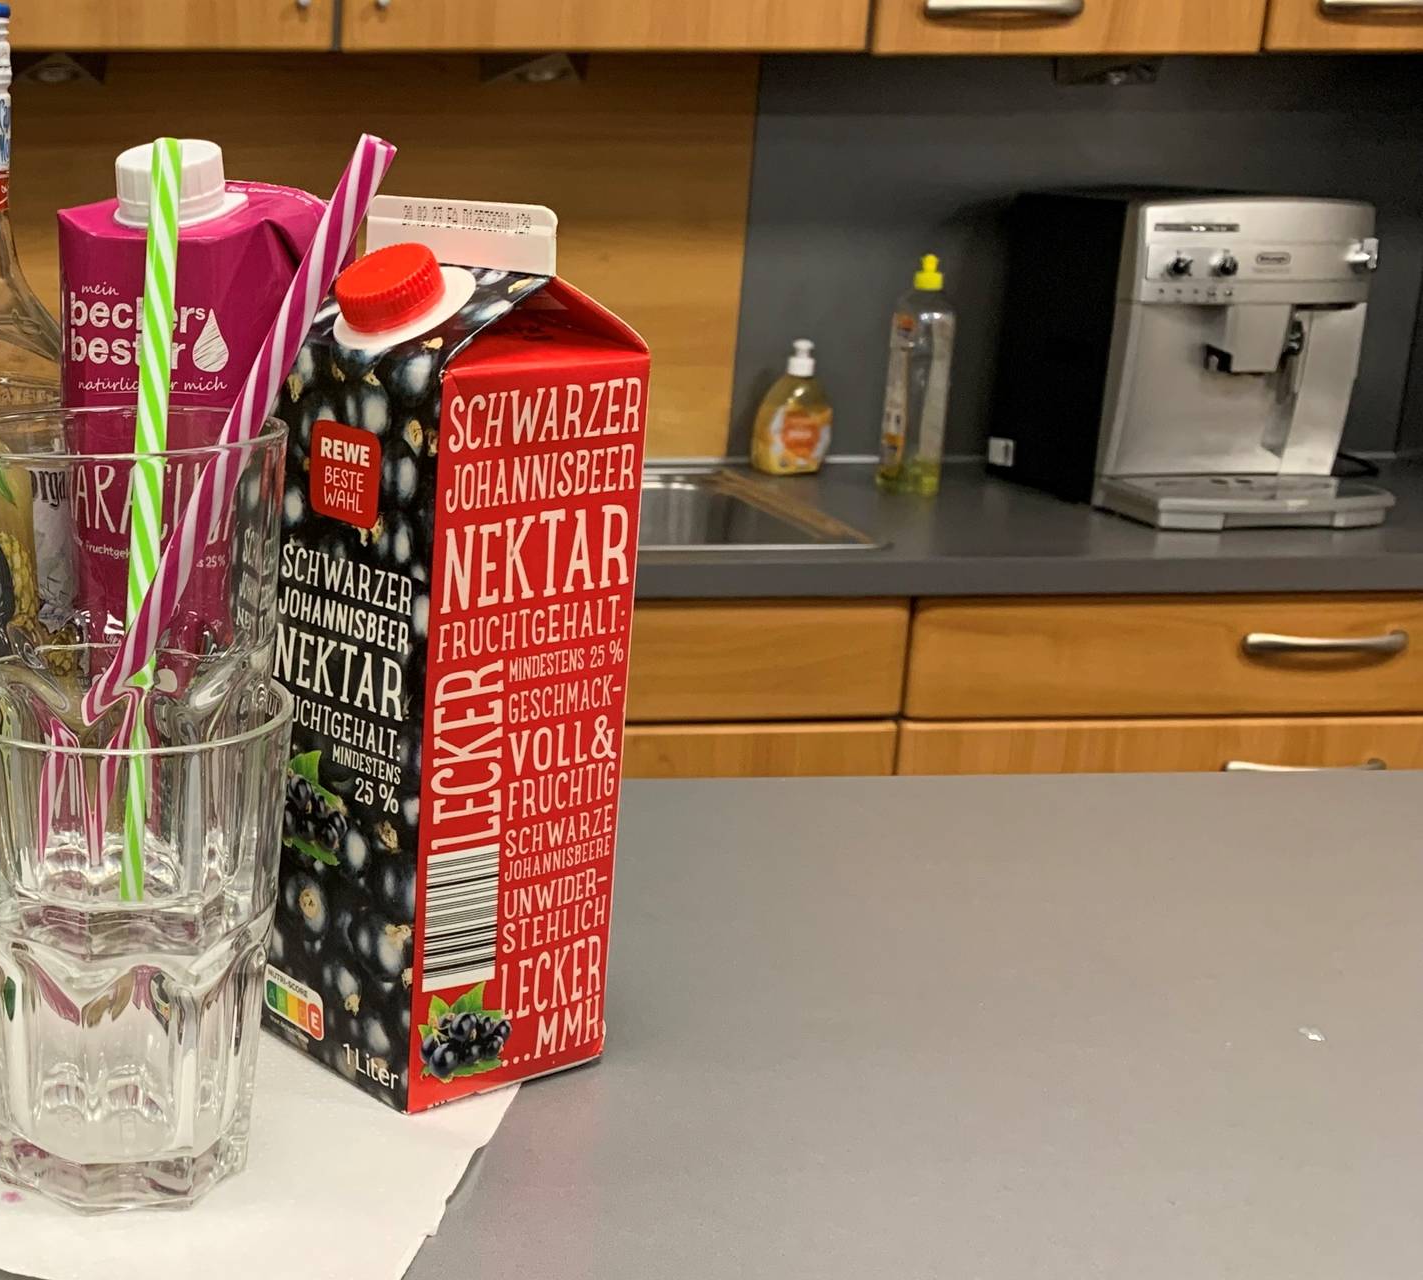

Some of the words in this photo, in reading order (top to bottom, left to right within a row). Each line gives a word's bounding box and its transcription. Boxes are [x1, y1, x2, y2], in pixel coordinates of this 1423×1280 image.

[70, 292, 206, 334] becrs
[81, 281, 120, 296] mein
[70, 328, 187, 370] bestr
[78, 376, 141, 392] natürlic
[183, 376, 227, 391] mich
[448, 376, 643, 454] SCHWARZER
[320, 436, 370, 468] REWE
[323, 485, 363, 514] WAHL
[324, 465, 364, 492] BESTE
[445, 443, 636, 514] JOHANNISBEER
[281, 543, 413, 617] SCHWARZER
[439, 503, 630, 615] NEKTAR
[278, 586, 409, 656] JOHANNISBEER
[436, 594, 626, 664] FRUCHTGEHALT:
[272, 622, 404, 722] NEKTAR
[508, 647, 585, 683] MINDESTENS
[589, 644, 605, 669] 25
[609, 637, 624, 665] %
[508, 674, 622, 725] GESCHMACK-
[291, 693, 402, 762] UCHTGEHALT:
[507, 714, 617, 777] VOLL&
[331, 743, 402, 786] MINDESTENS
[430, 659, 505, 850] LECKER
[354, 776, 374, 806] 25
[379, 783, 399, 815] %
[506, 761, 616, 822] FRUCHTIG
[504, 804, 613, 858] SCHWARZE
[504, 834, 612, 883] JOHANNISBEERE
[503, 867, 608, 920] UNWIDER-
[502, 894, 607, 954] STEHLICH
[501, 935, 601, 1021] LECKER
[310, 1010, 321, 1031] E
[343, 1043, 351, 1066] 1
[355, 1048, 399, 1090] Liter
